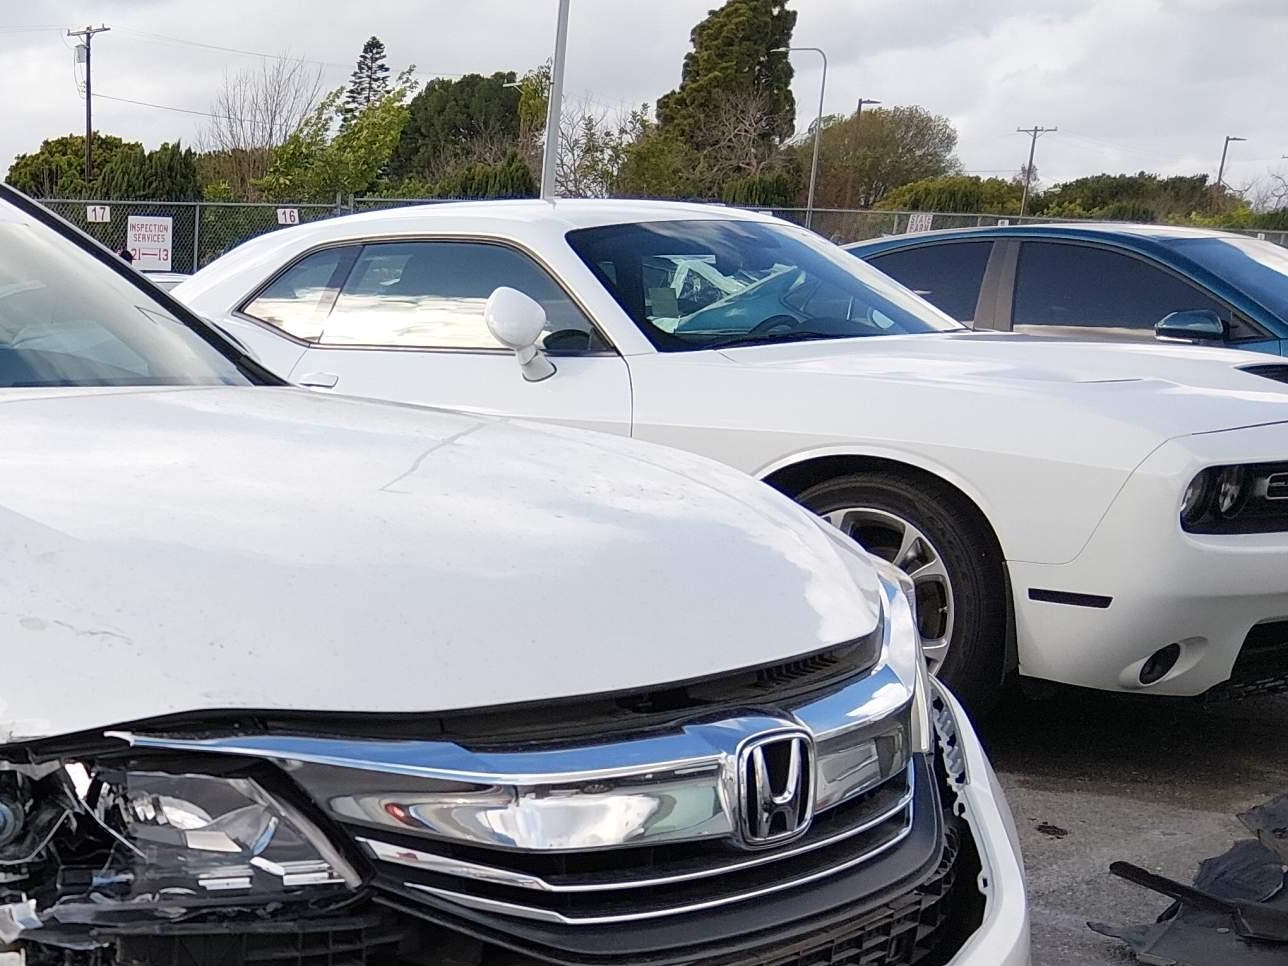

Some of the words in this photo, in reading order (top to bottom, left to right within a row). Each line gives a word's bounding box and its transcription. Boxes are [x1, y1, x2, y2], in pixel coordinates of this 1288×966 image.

[91, 206, 106, 221] 17
[282, 209, 296, 223] 16
[129, 223, 169, 233] INSPECTION
[133, 233, 166, 243] SERVICES
